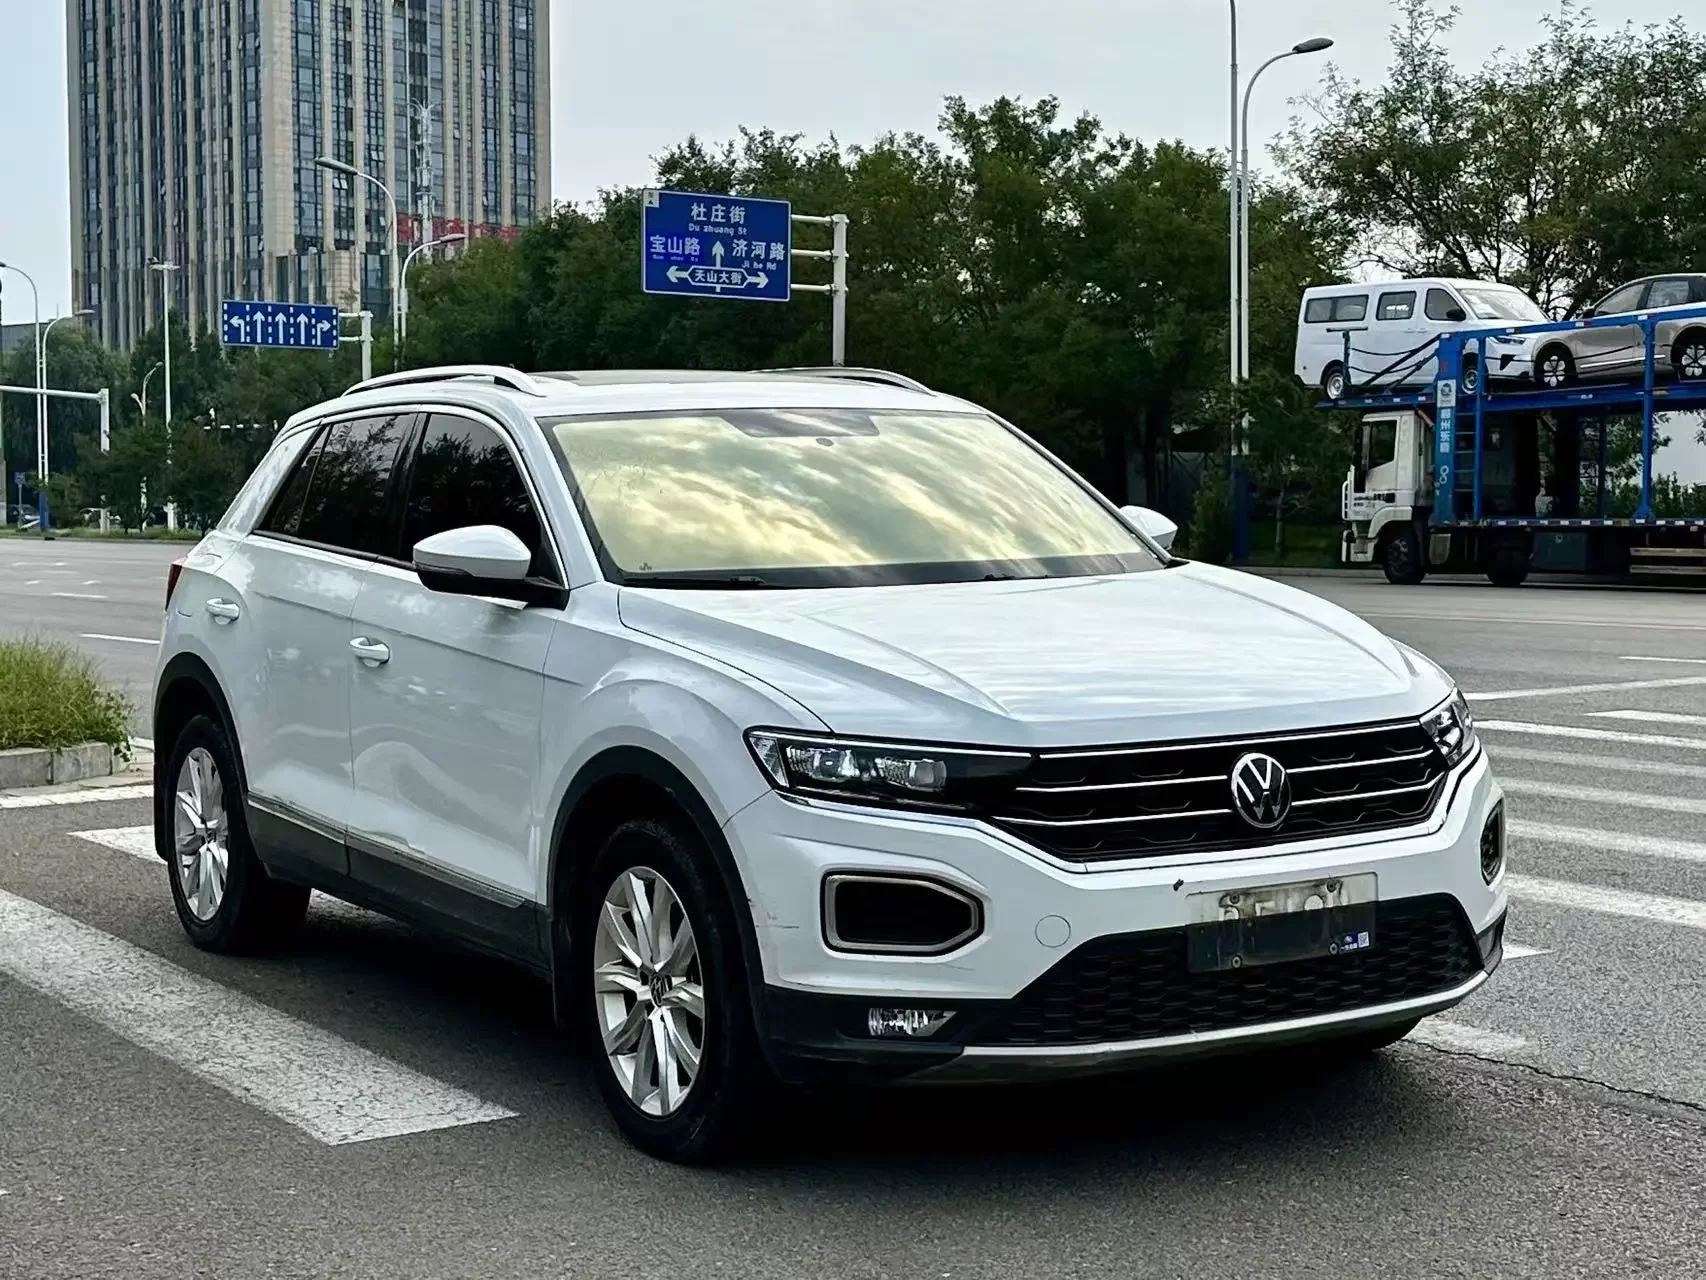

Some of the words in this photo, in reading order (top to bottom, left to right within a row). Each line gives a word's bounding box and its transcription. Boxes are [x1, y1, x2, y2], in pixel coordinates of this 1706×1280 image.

[690, 202, 746, 224] 杜庄街
[688, 223, 700, 232] Du
[737, 226, 748, 235] St
[650, 235, 700, 255] 宝山路
[732, 239, 785, 260] 济河路
[766, 261, 777, 270] Rd
[695, 269, 742, 285] 天山大街
